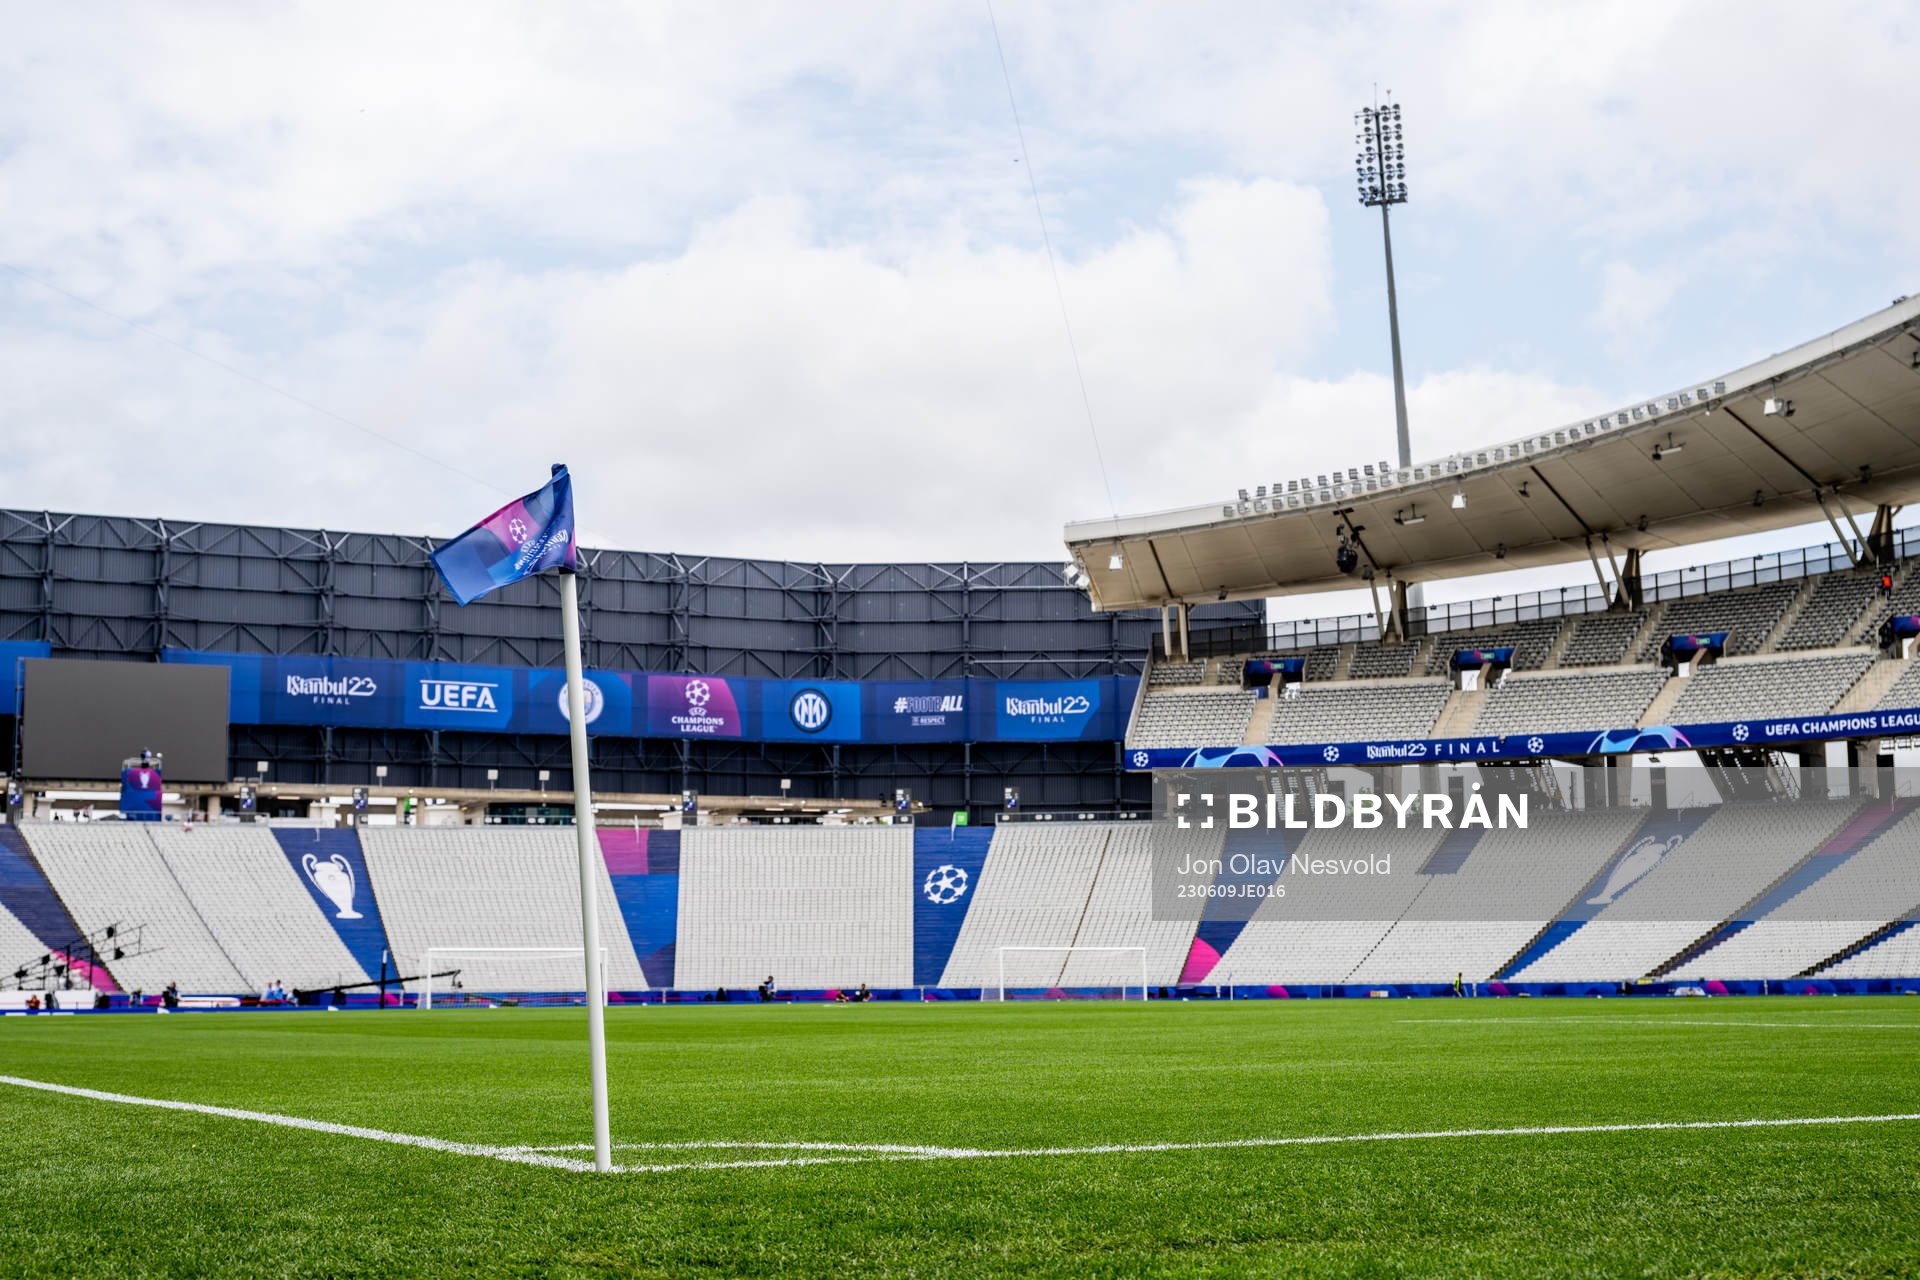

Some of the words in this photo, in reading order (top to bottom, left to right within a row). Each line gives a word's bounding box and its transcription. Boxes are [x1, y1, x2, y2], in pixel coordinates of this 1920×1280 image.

[313, 696, 350, 705] FINAL
[421, 683, 497, 709] UEFA
[671, 715, 725, 726] CHAMPIONS
[1031, 715, 1065, 723] FINAL
[680, 724, 715, 733] LEAGUE
[1765, 724, 1799, 736] UEFA
[1802, 717, 1877, 734] CHAMPIONS
[1435, 741, 1500, 755] FINAL
